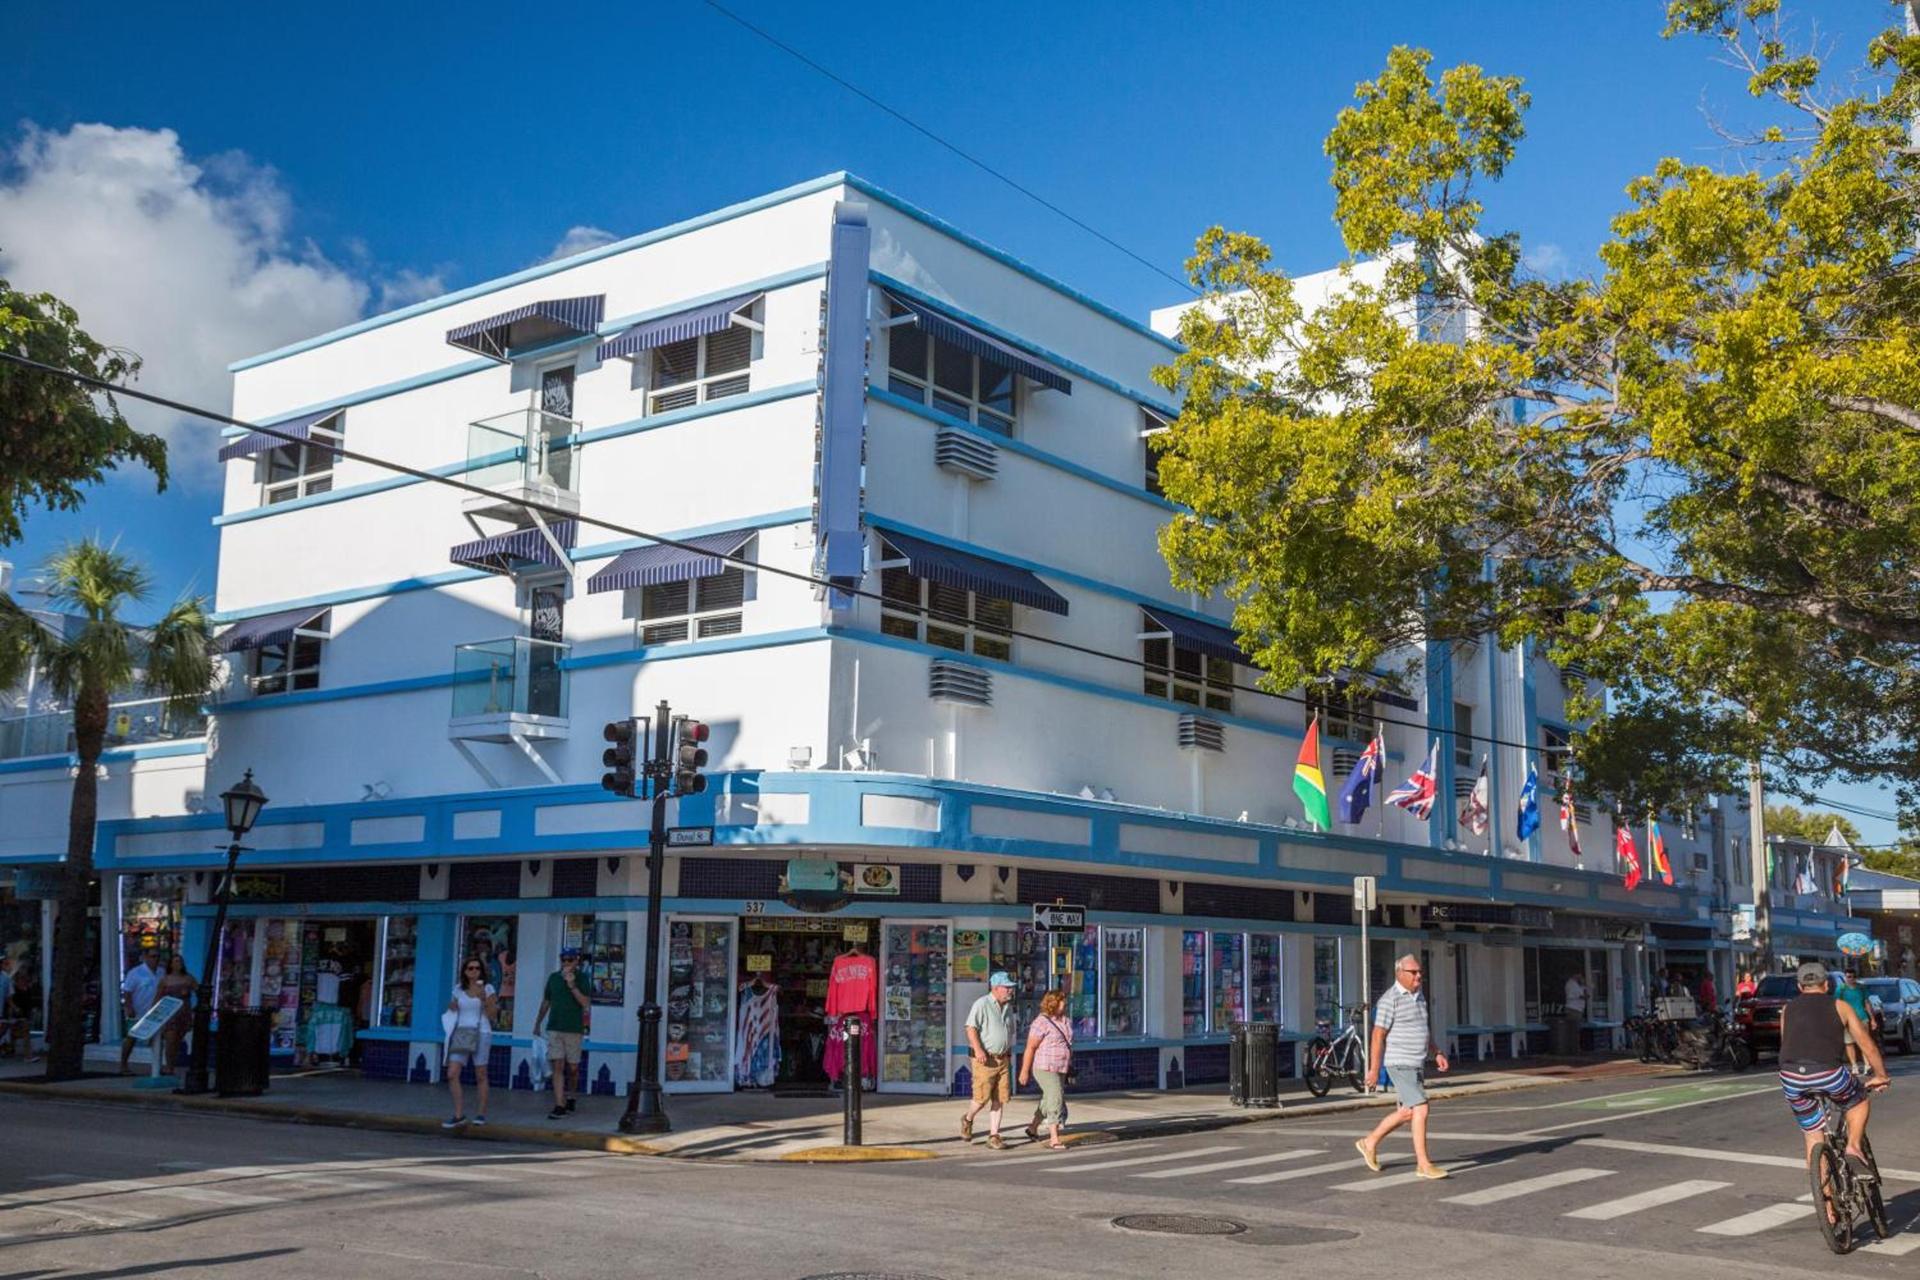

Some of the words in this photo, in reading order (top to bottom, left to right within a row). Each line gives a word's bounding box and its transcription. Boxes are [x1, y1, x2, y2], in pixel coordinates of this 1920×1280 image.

[746, 901, 765, 913] 537
[1050, 914, 1065, 925] ONE
[1066, 914, 1081, 925] WAY
